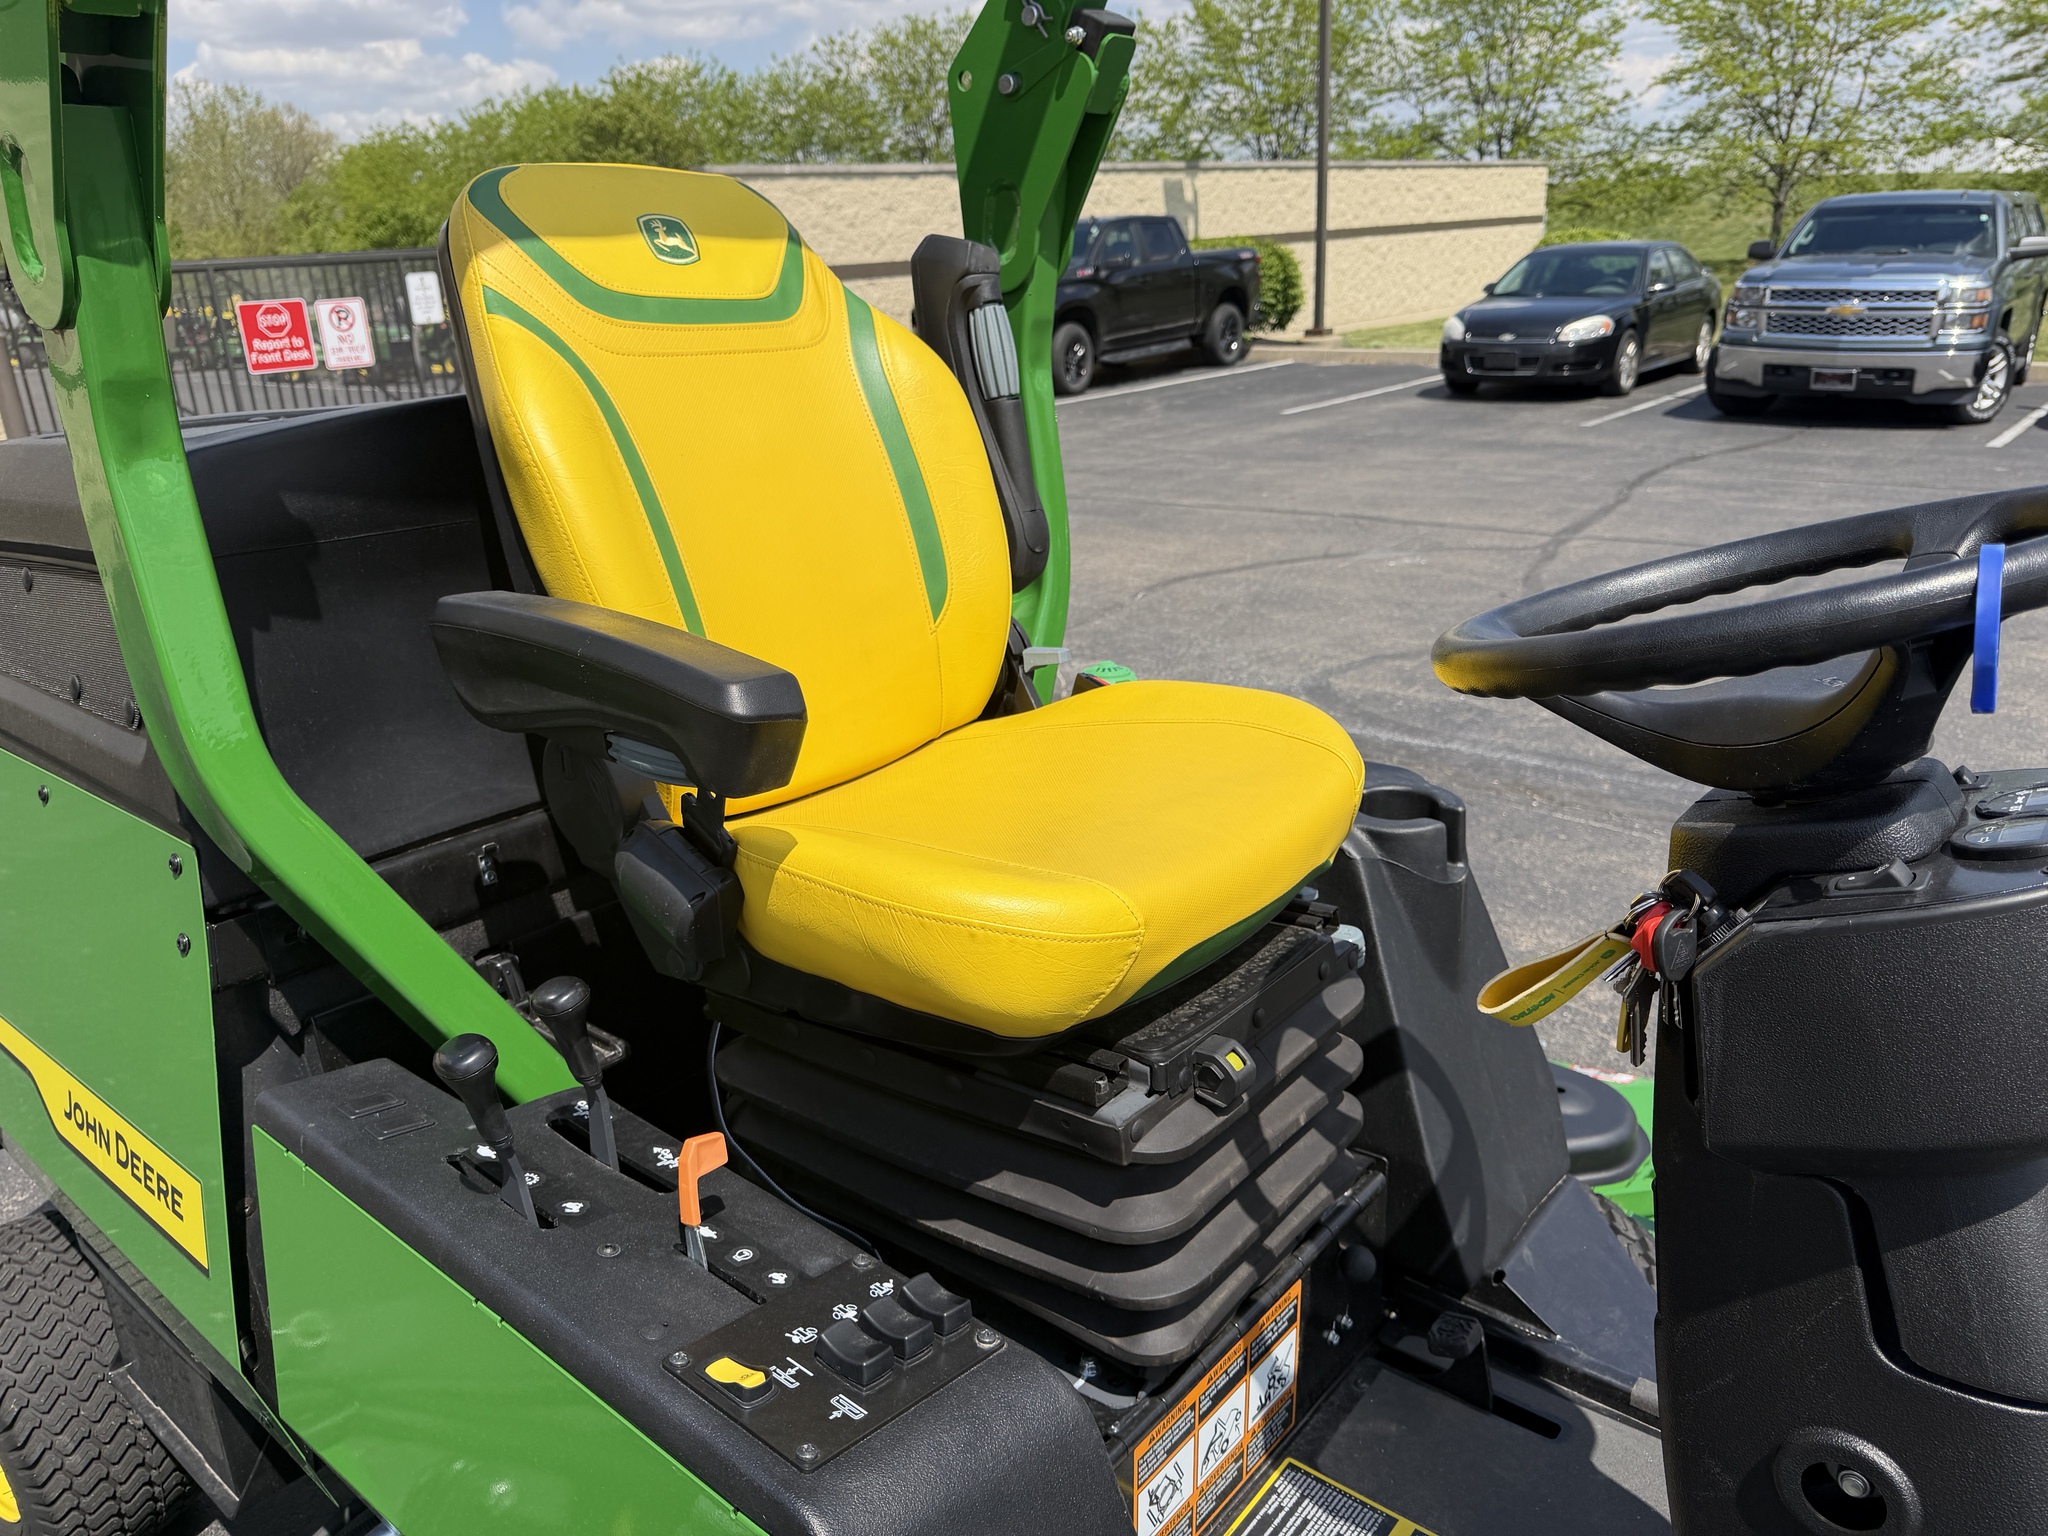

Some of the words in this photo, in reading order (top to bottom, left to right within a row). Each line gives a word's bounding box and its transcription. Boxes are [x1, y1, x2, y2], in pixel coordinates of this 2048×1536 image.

[259, 313, 288, 327] STOP
[250, 351, 283, 365] Front
[283, 348, 311, 362] Desk
[252, 336, 291, 352] Report
[291, 335, 305, 348] to
[64, 1089, 111, 1157] JOHN
[114, 1129, 184, 1223] DEERE
[1265, 1292, 1292, 1326] WARNING
[1213, 1343, 1243, 1378] WARNING
[1155, 1400, 1188, 1438] WARNING
[1205, 1441, 1244, 1486] ADVERTENCIA
